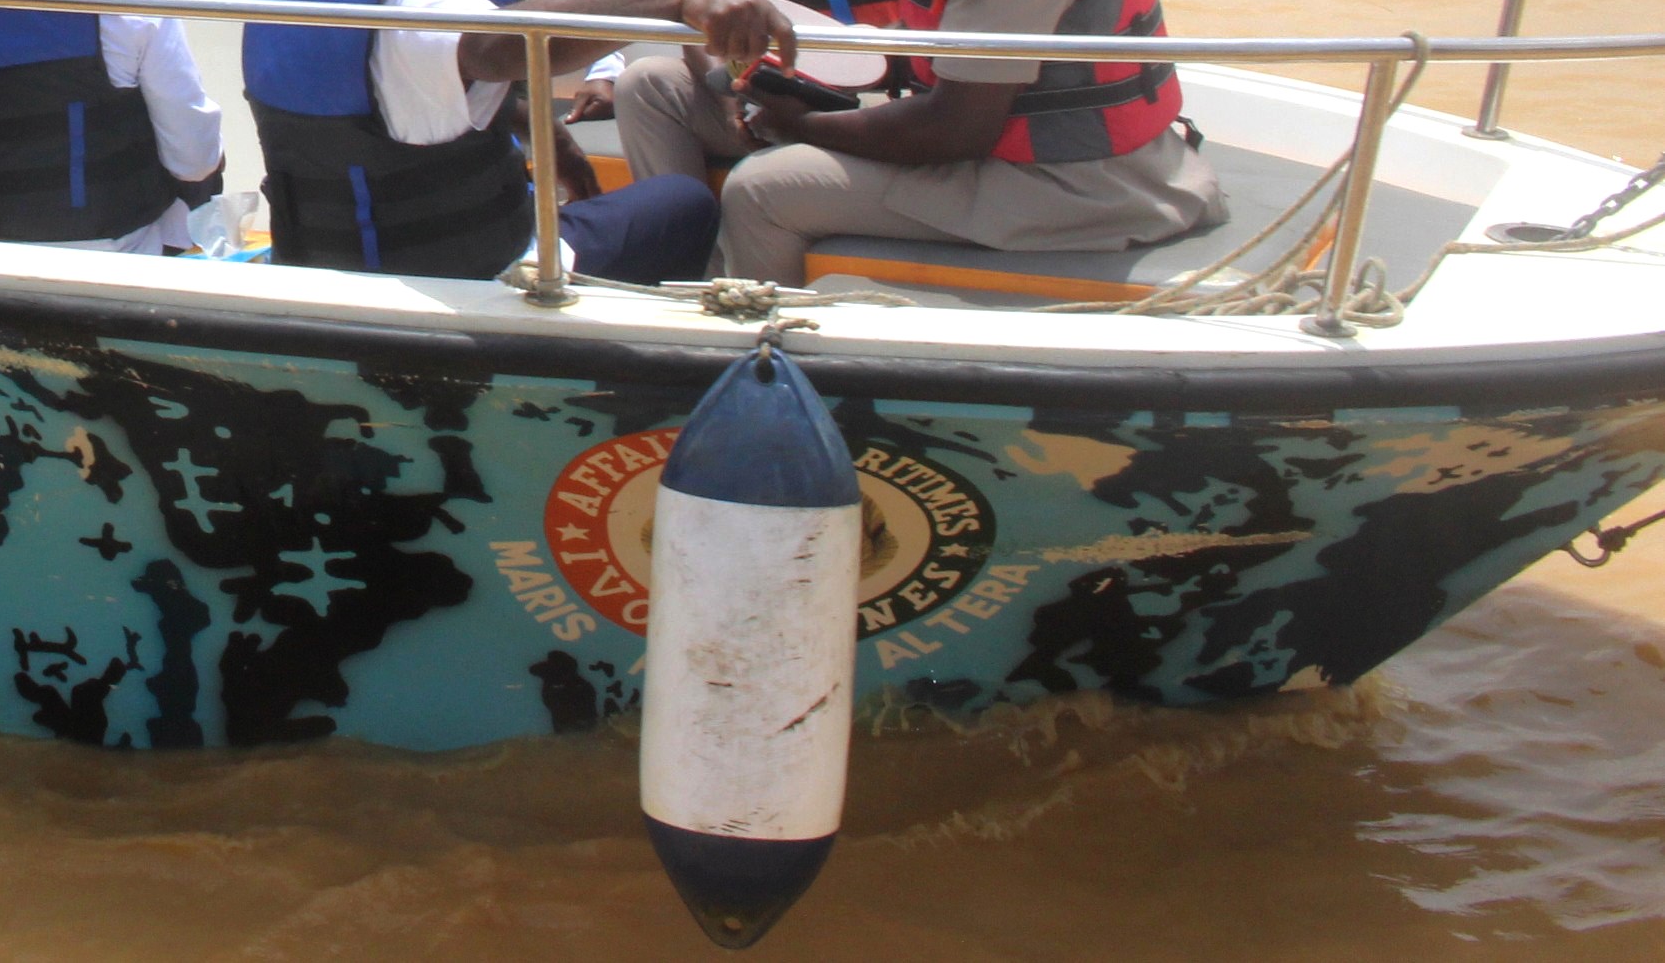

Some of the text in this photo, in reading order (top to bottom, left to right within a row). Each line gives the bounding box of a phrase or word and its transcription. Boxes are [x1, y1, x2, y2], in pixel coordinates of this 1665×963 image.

[557, 432, 981, 537] AFFAI RITIMES
[489, 540, 597, 642] MARIS
